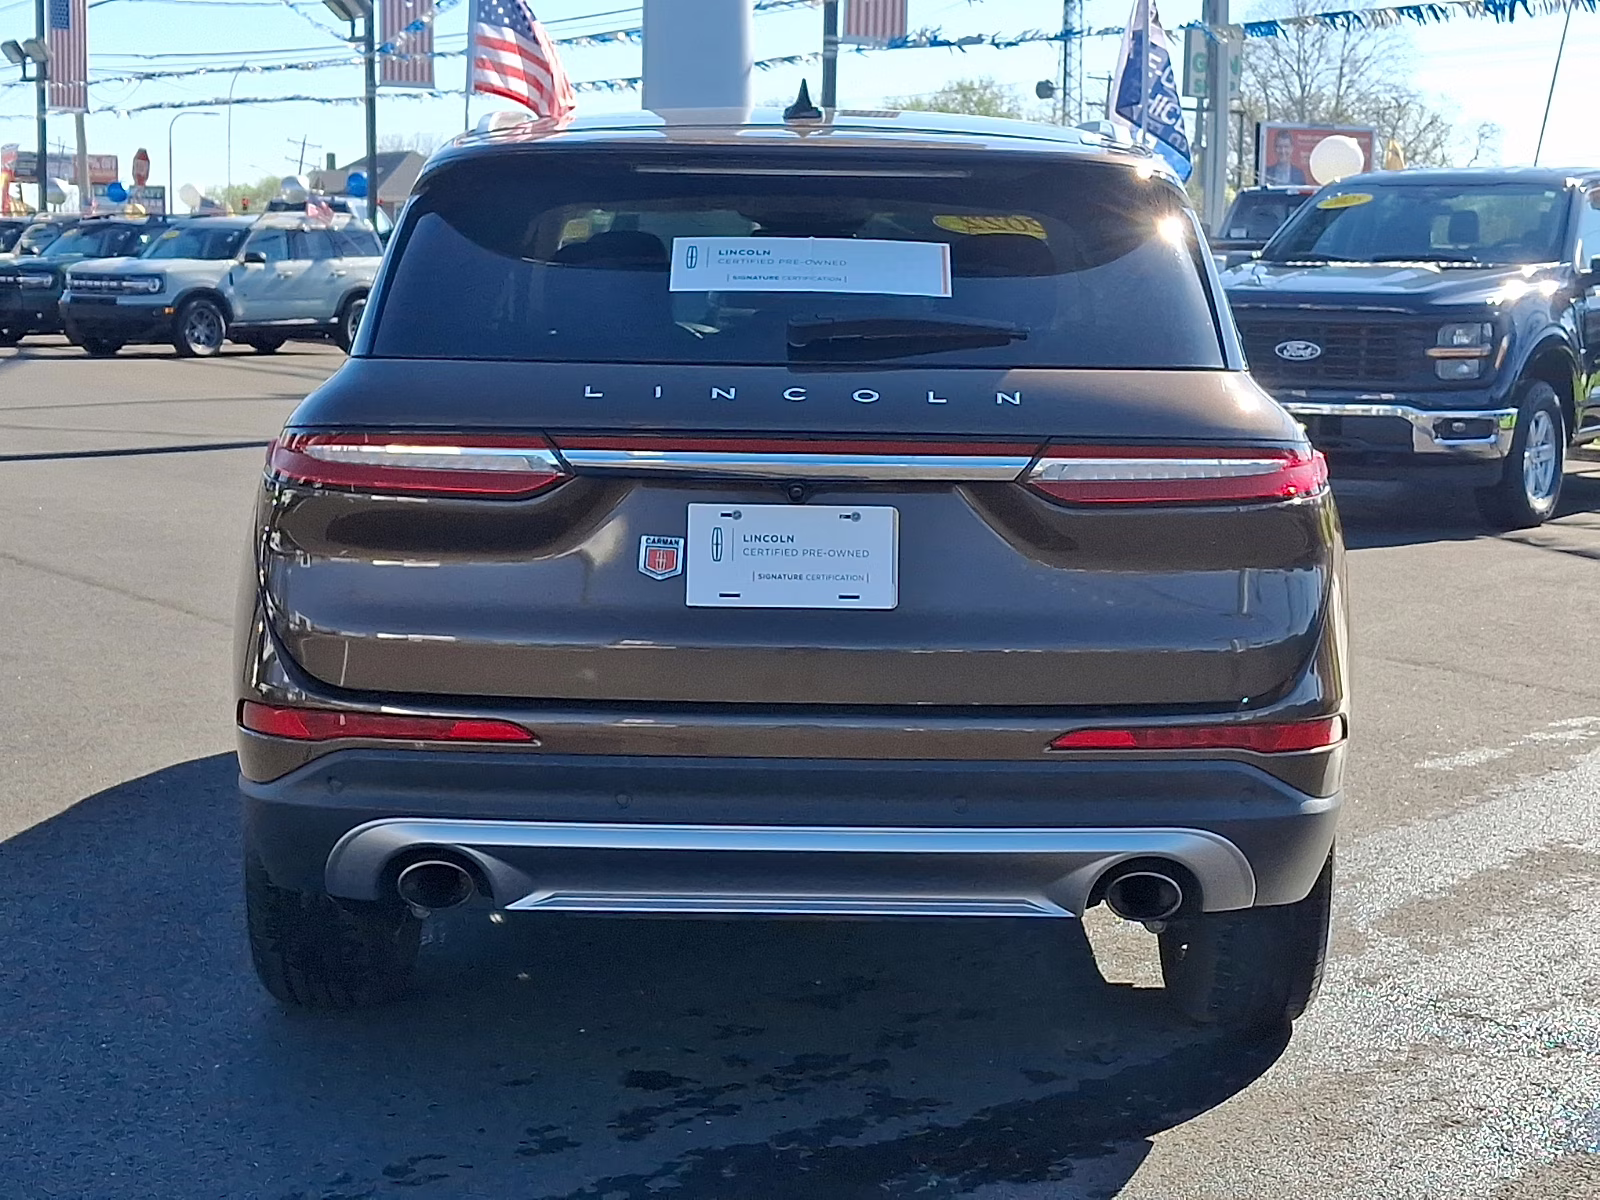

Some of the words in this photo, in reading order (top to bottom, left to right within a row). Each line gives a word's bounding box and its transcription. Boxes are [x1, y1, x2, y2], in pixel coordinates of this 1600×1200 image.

[778, 259, 848, 267] PRE-OWNED
[584, 385, 1021, 406] LINCOLN
[645, 537, 680, 546] CARMAN
[743, 534, 795, 544] LINCOLN
[742, 547, 799, 557] CERTIFIED
[802, 549, 870, 558] PRE-OWNED
[757, 573, 803, 581] SIGNATURE
[805, 574, 865, 582] CERTIFICATION
